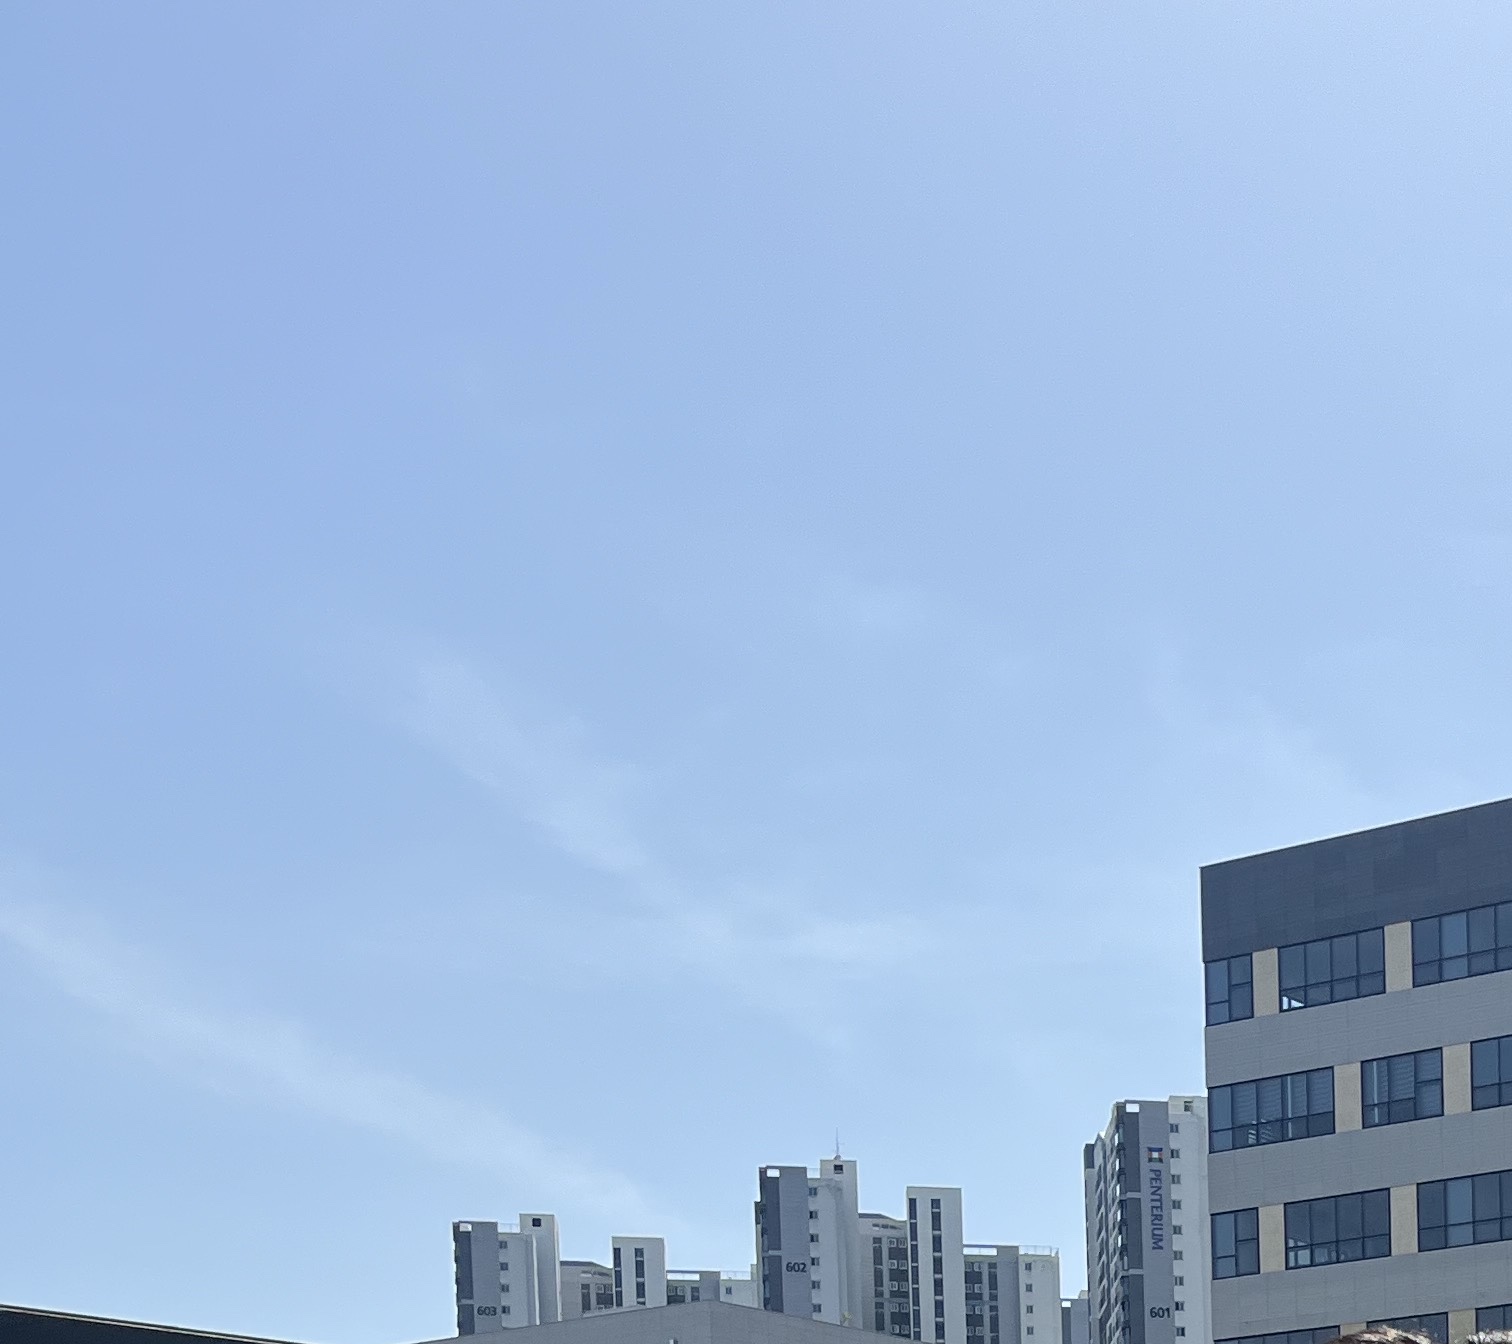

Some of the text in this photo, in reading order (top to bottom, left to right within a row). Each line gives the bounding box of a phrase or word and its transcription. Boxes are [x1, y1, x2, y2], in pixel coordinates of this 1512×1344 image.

[1149, 1168, 1164, 1250] PENTERIUM
[786, 1261, 807, 1273] 602
[477, 1305, 497, 1316] 603
[1149, 1306, 1171, 1320] 601
